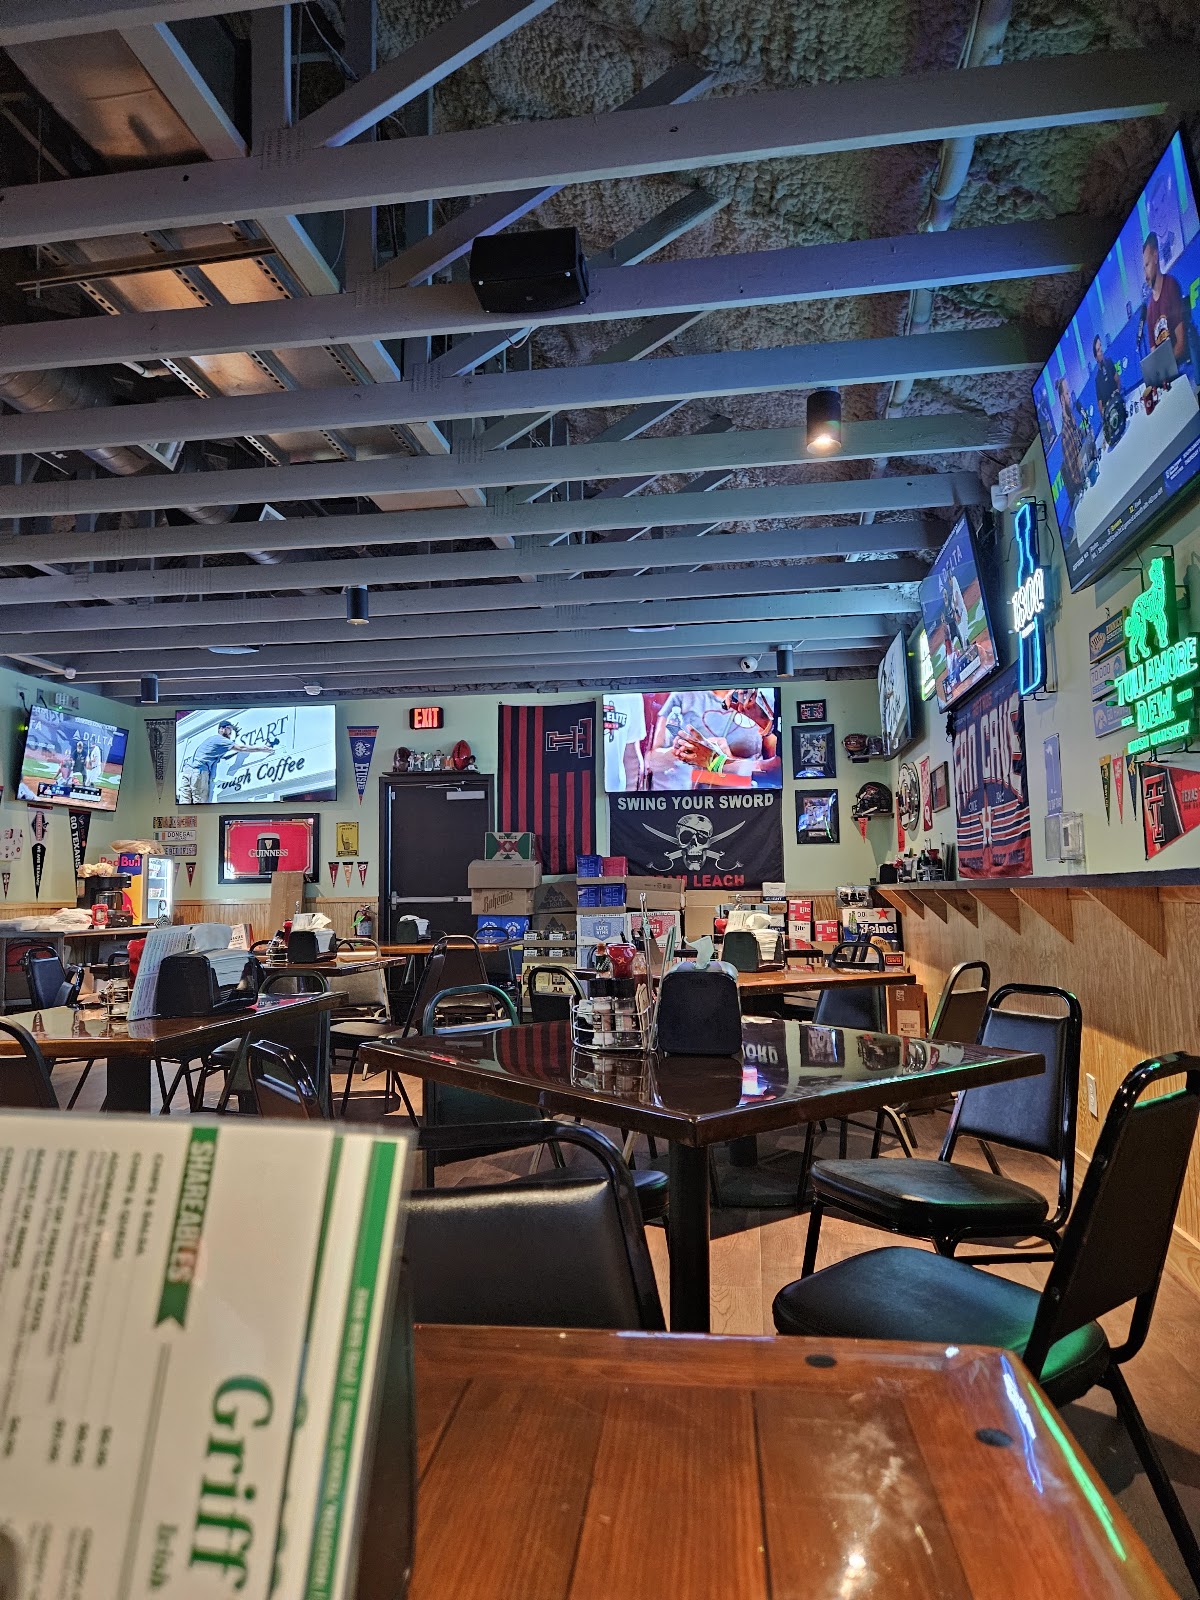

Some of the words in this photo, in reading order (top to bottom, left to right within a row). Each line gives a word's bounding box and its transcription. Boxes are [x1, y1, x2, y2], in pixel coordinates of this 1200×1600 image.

[1114, 637, 1198, 706] TULLAMORE
[240, 715, 288, 746] START
[414, 707, 439, 728] EXIT
[1150, 720, 1189, 746] WHISKEY
[257, 756, 305, 783] Coffee
[617, 796, 667, 811] SWING
[671, 795, 715, 809] YOUR
[719, 793, 774, 809] SWORD
[70, 816, 78, 830] GO
[248, 848, 289, 858] GUINNESS
[693, 874, 745, 888] LEACH
[482, 890, 514, 913] Bohemia
[167, 1141, 215, 1283] SHAREABLES
[189, 1374, 275, 1592] Griff
[149, 1522, 178, 1592] Irish
